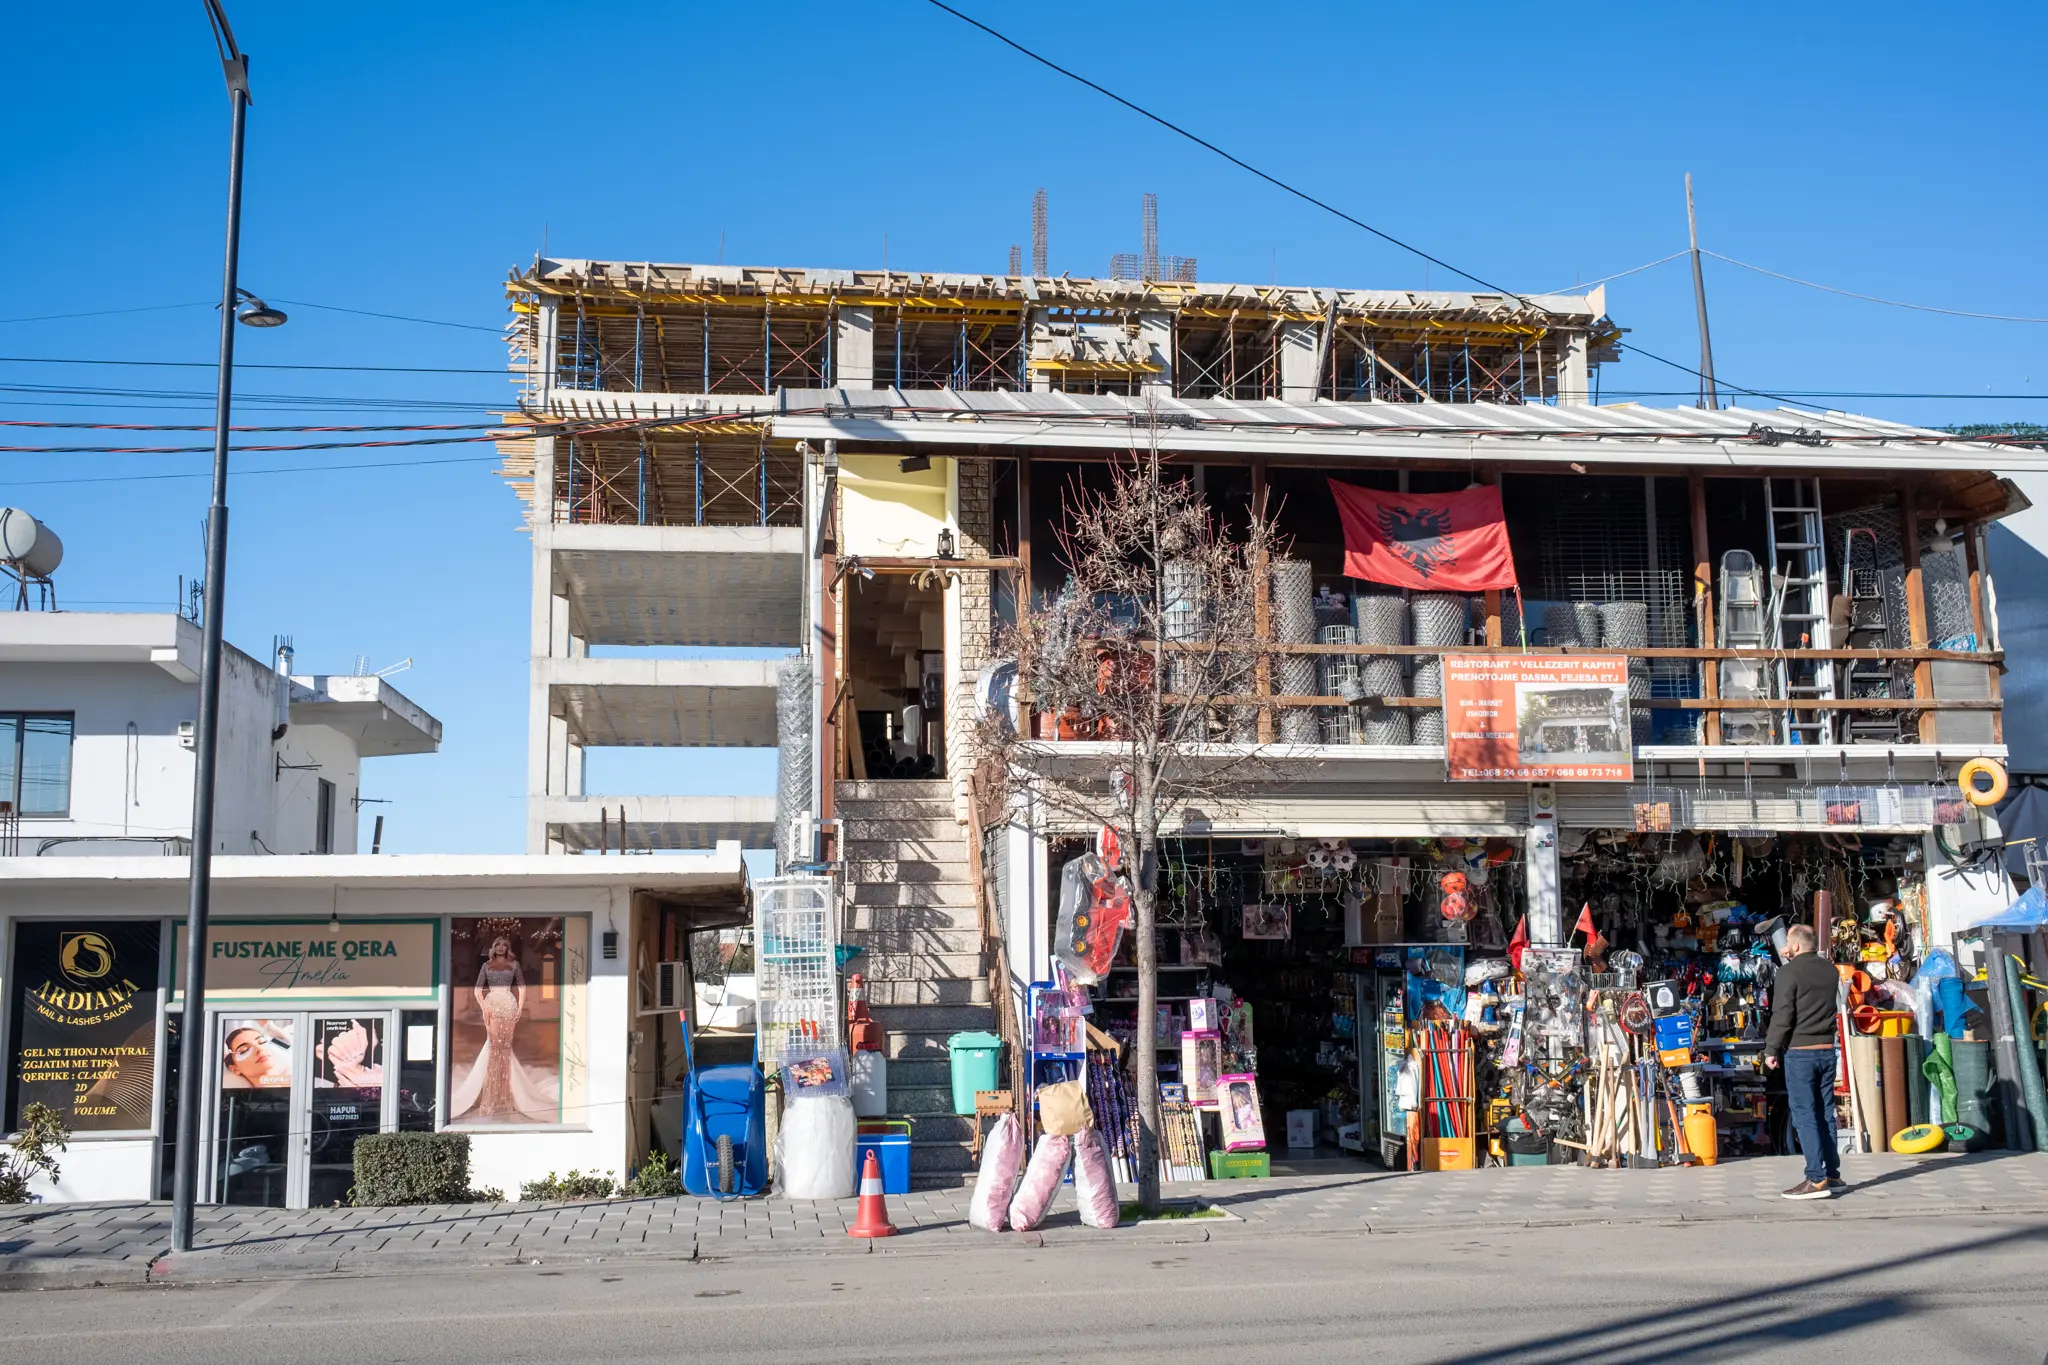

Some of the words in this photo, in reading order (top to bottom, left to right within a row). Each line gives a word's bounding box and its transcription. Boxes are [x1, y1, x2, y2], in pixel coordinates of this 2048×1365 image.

[1450, 661, 1510, 669] RESTORANT
[1520, 661, 1580, 669] VELLEZERIT
[1582, 661, 1616, 670] KAPITI
[1450, 673, 1518, 681] PRENOTOJME
[1521, 674, 1558, 682] DASMA,
[1561, 674, 1598, 682] FEJESA
[1485, 731, 1515, 739] NDERTIMI
[212, 941, 302, 958] FUSTANE
[307, 941, 337, 957] ME
[341, 940, 397, 961] QERA
[259, 951, 350, 993] Amelia
[33, 979, 140, 1011] ARDIANA
[37, 1004, 55, 1020] NAIL
[57, 1015, 64, 1023] &
[67, 1015, 102, 1026] LASHES
[104, 1002, 133, 1021] SALON
[24, 1048, 45, 1057] GEL
[47, 1048, 62, 1057] NE
[63, 1048, 98, 1057] THONJ
[99, 1047, 149, 1056] NATYRAL
[23, 1060, 70, 1069] ZGJATIM
[72, 1060, 89, 1068] ME
[90, 1059, 120, 1068] TIPSA
[22, 1072, 70, 1083] QERPIKE
[77, 1071, 120, 1080] CLASSIC
[74, 1083, 88, 1092] 2D
[73, 1095, 87, 1104] 3D
[73, 1106, 117, 1116] VOLUME
[330, 1106, 356, 1114] HAPUR
